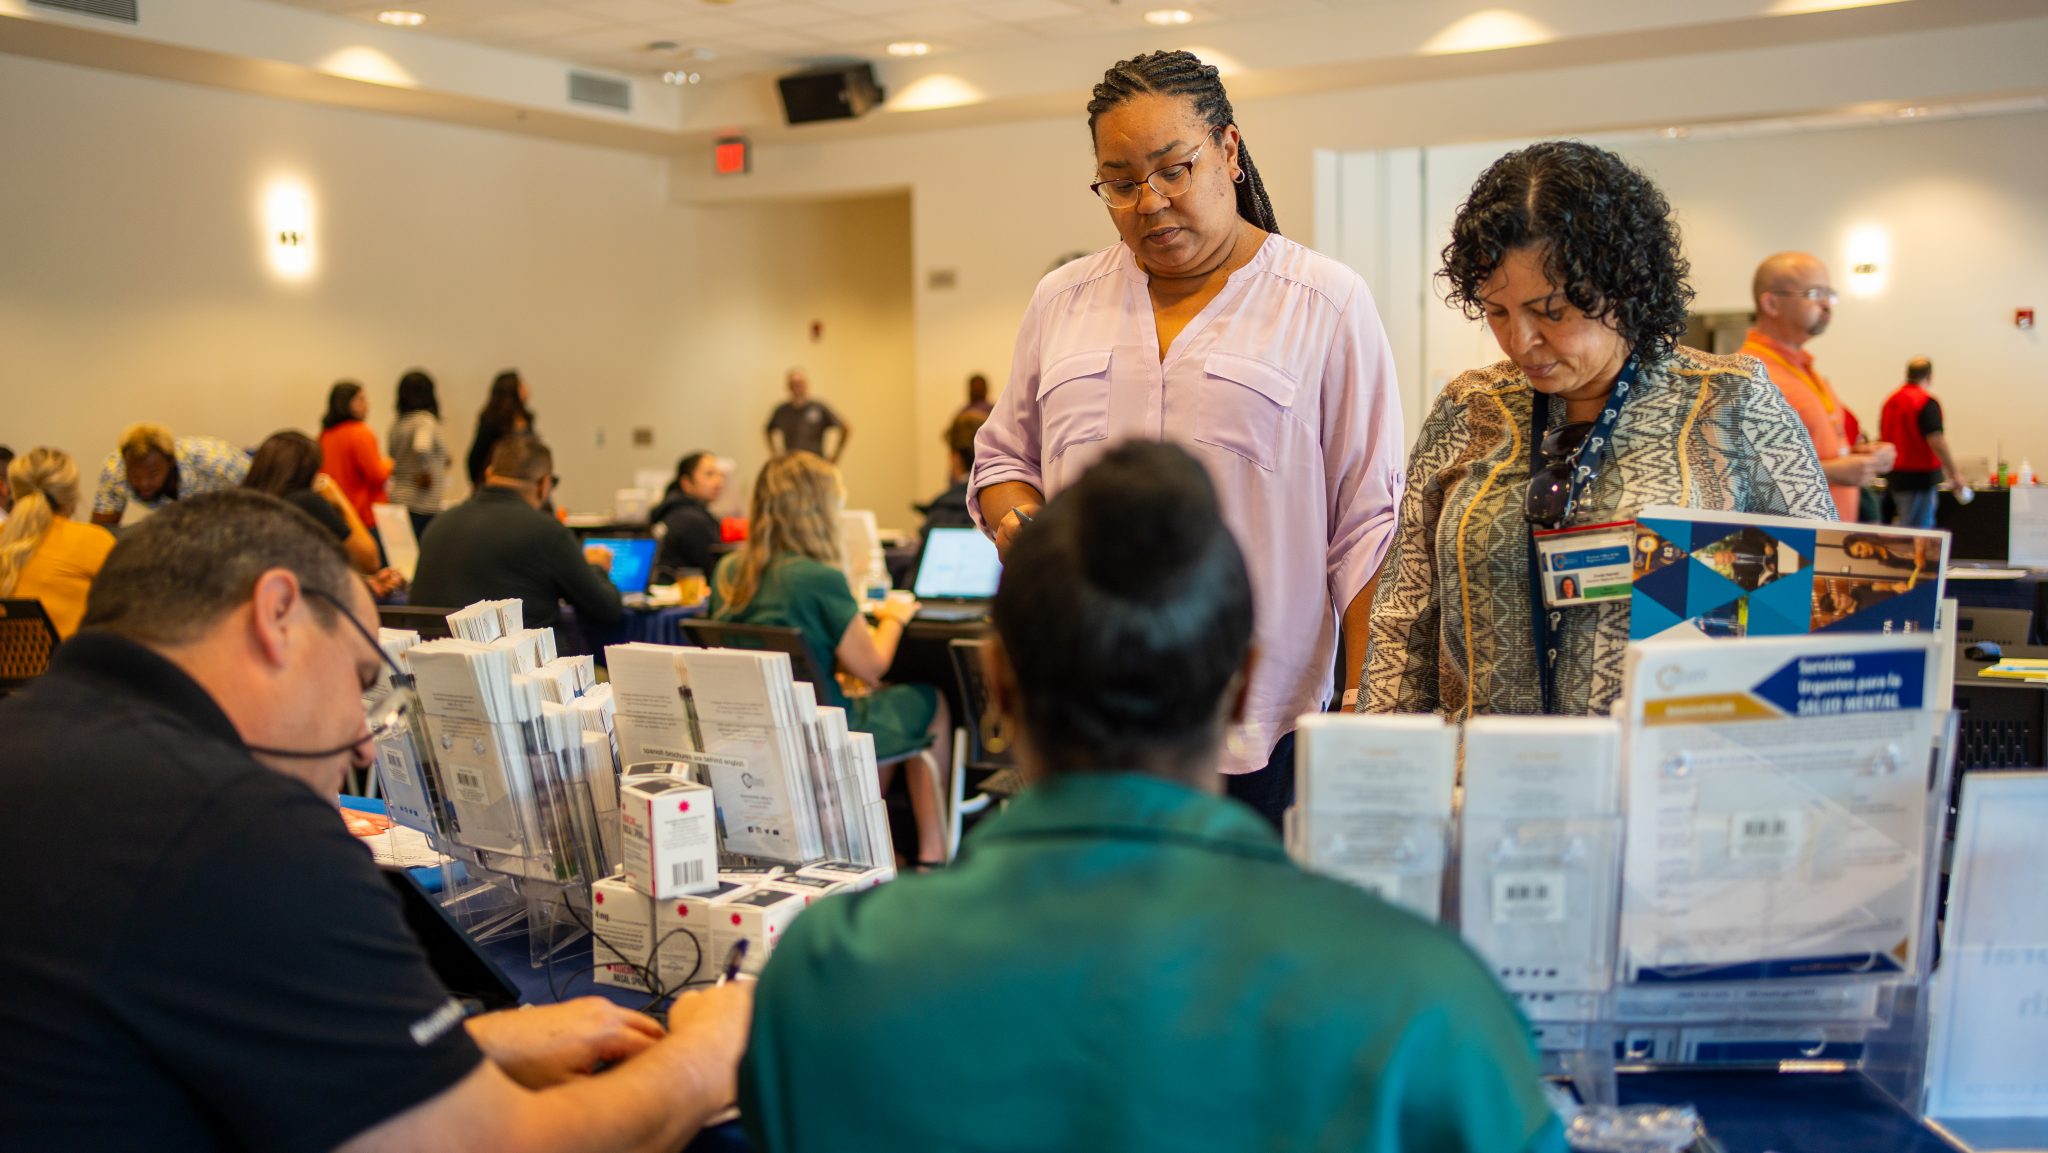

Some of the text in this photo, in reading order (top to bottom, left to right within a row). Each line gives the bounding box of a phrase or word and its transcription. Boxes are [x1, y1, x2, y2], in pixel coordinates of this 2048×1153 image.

[1798, 659, 1855, 675] Servicios
[1798, 670, 1902, 696] Urgentes para la
[1797, 692, 1899, 716] SALUD MENTAL
